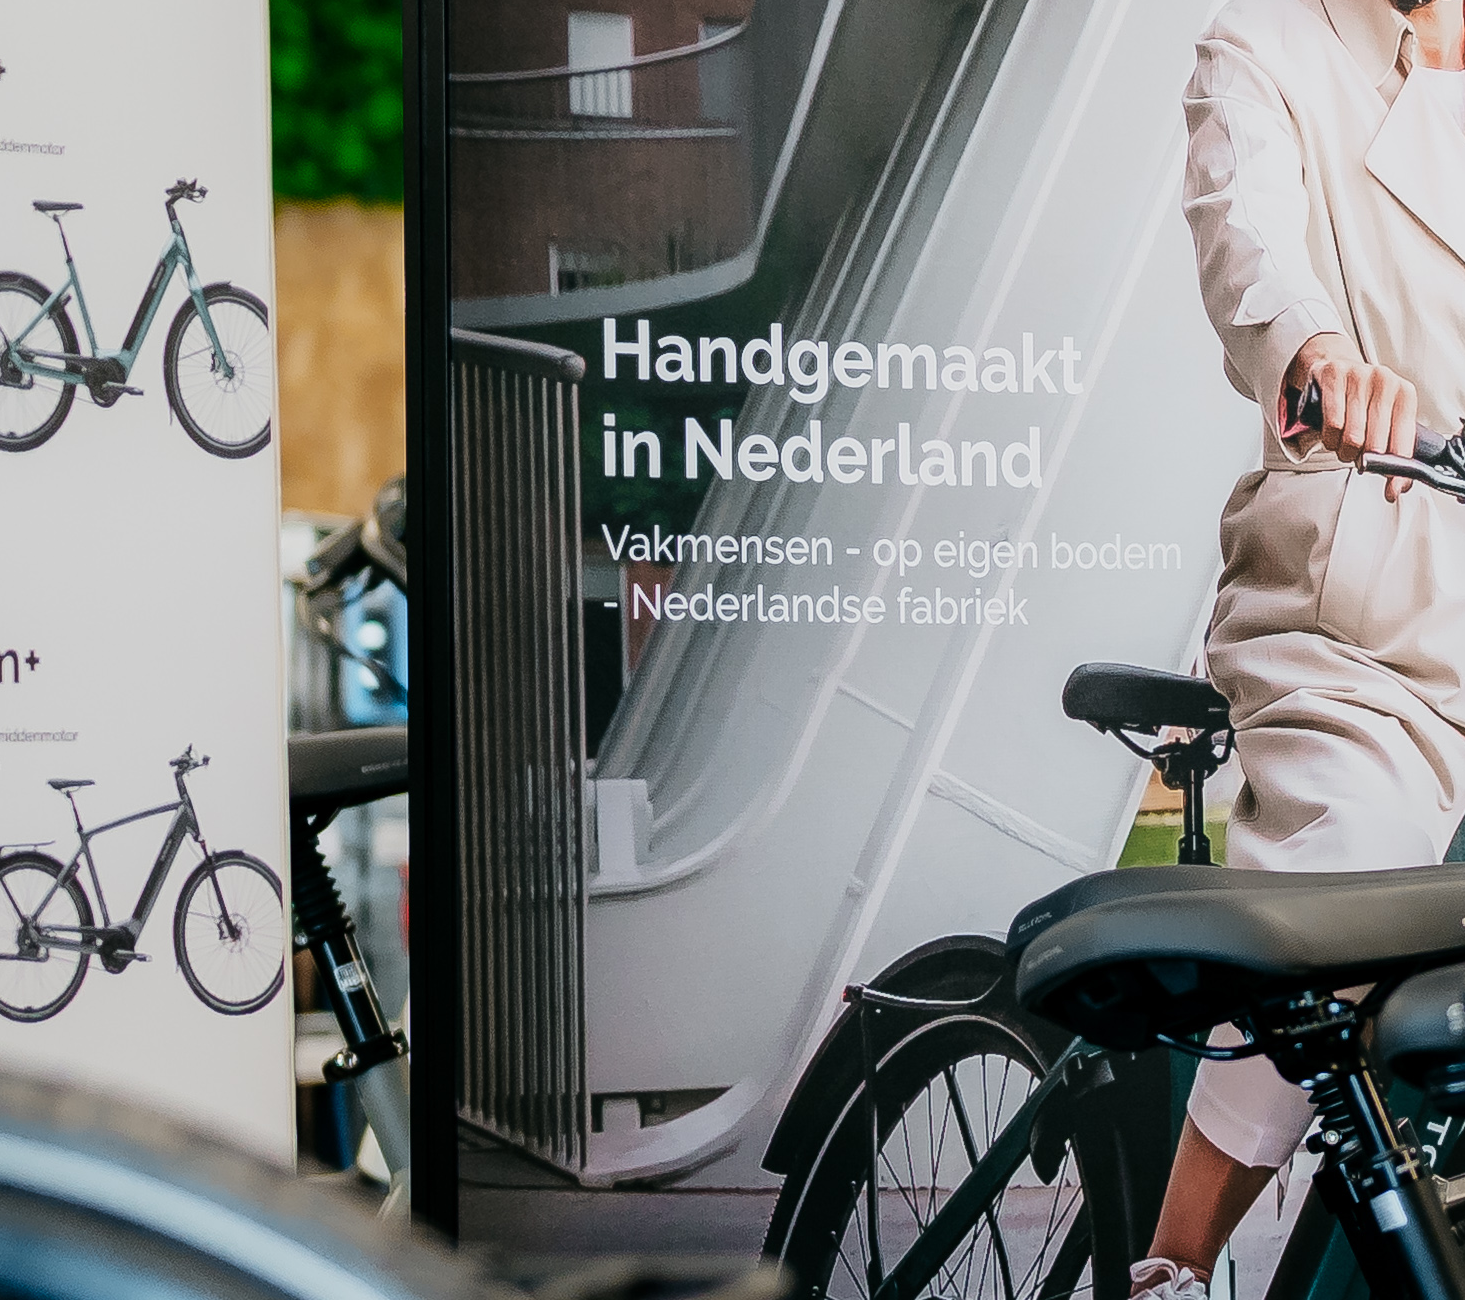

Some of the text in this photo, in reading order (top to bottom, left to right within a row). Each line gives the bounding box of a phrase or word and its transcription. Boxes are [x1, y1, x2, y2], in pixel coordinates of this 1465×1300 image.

[603, 317, 1085, 406] Handgemaakt
[603, 413, 1044, 489] in Nederland
[602, 523, 833, 567] Vakmensen
[872, 541, 923, 574] op
[934, 532, 1038, 579] eigen
[1050, 532, 1182, 570] bodem
[632, 582, 886, 625] Nederlandse
[897, 587, 1030, 626] fabriek
